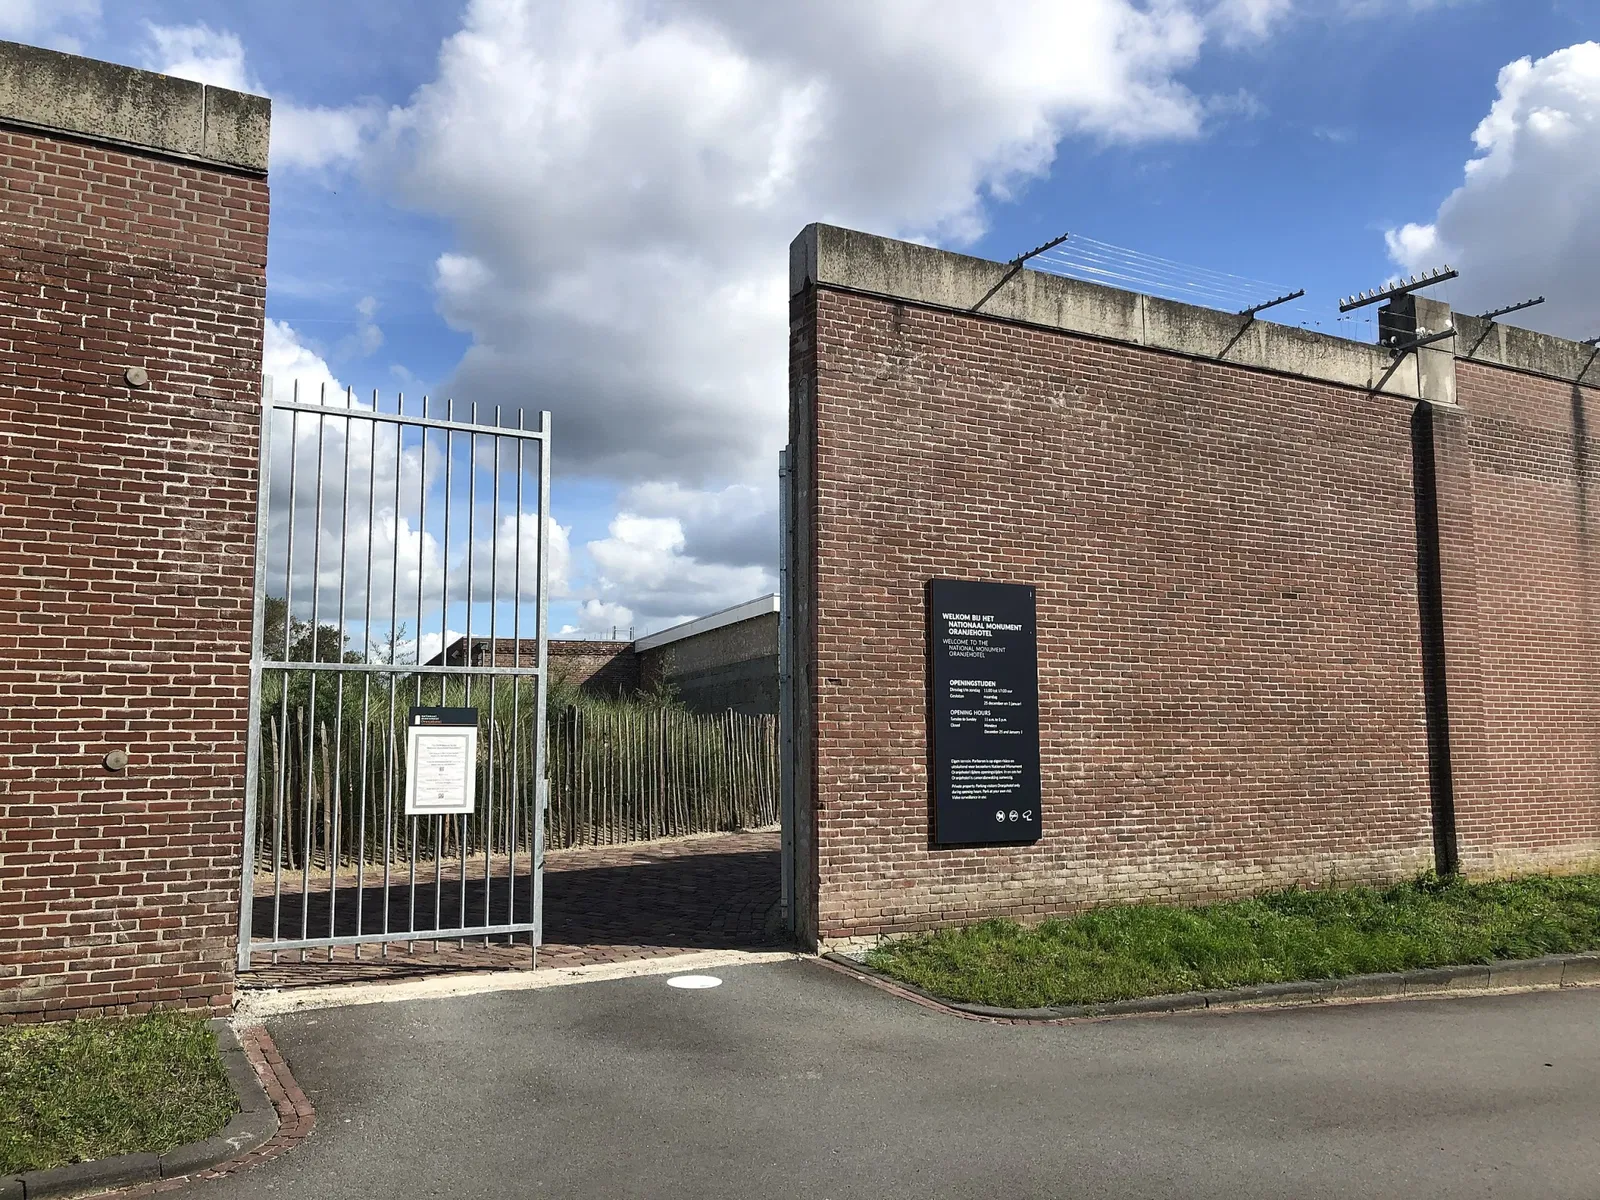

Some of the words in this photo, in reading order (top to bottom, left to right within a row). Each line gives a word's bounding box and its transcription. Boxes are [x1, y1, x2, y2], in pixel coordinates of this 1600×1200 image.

[948, 621, 984, 629] NATIONAAL
[986, 623, 1022, 631] MONUMENT
[948, 628, 992, 636] ORANJEHOTEL
